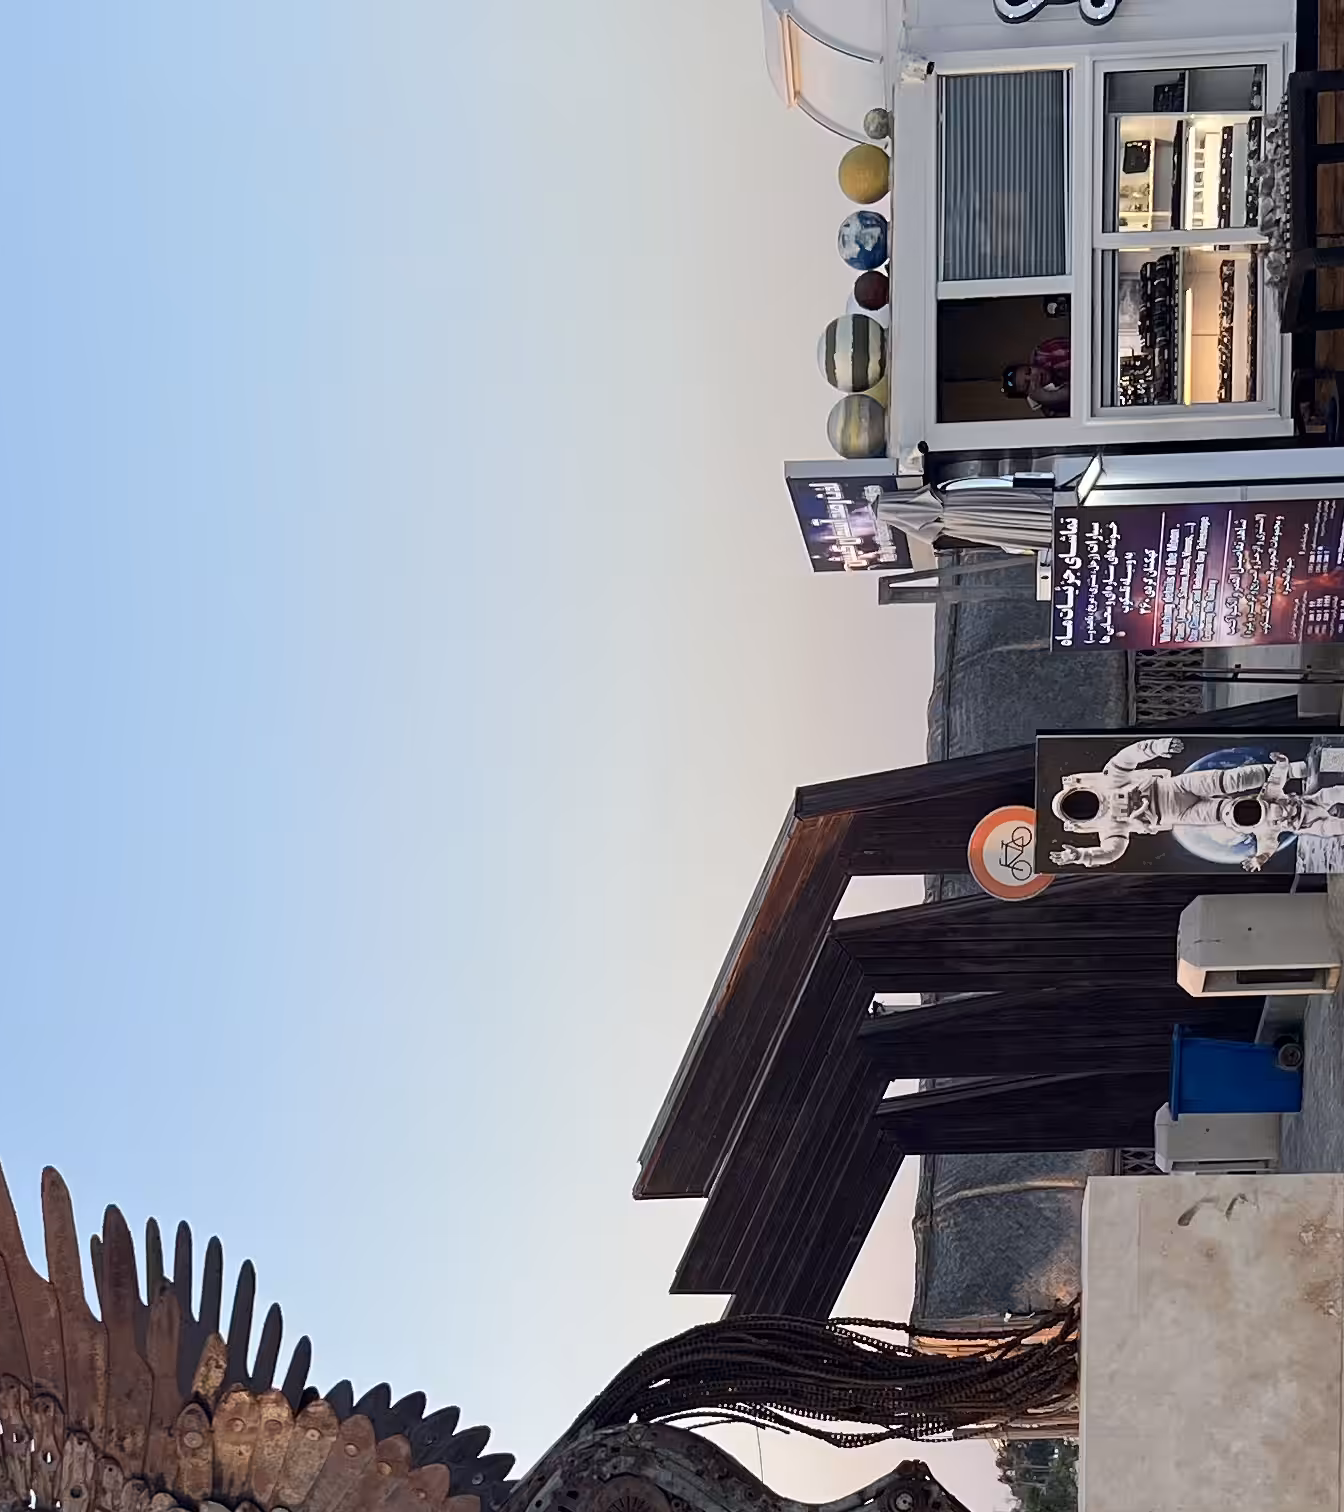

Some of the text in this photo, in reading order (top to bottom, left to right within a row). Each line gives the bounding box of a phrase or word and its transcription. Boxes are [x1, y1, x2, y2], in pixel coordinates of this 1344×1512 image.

[1084, 522, 1103, 553] سیارات
[1104, 522, 1120, 548] خوشه
[1166, 528, 1180, 552] Moon
[1104, 550, 1118, 564] های
[1142, 548, 1158, 578] کهکشان
[1165, 552, 1177, 566] the
[1054, 518, 1082, 646] تماشای جزئیات ماه
[1120, 559, 1136, 585] وسیله
[1165, 566, 1176, 575] of
[1162, 576, 1176, 602] details
[1192, 590, 1202, 602] and
